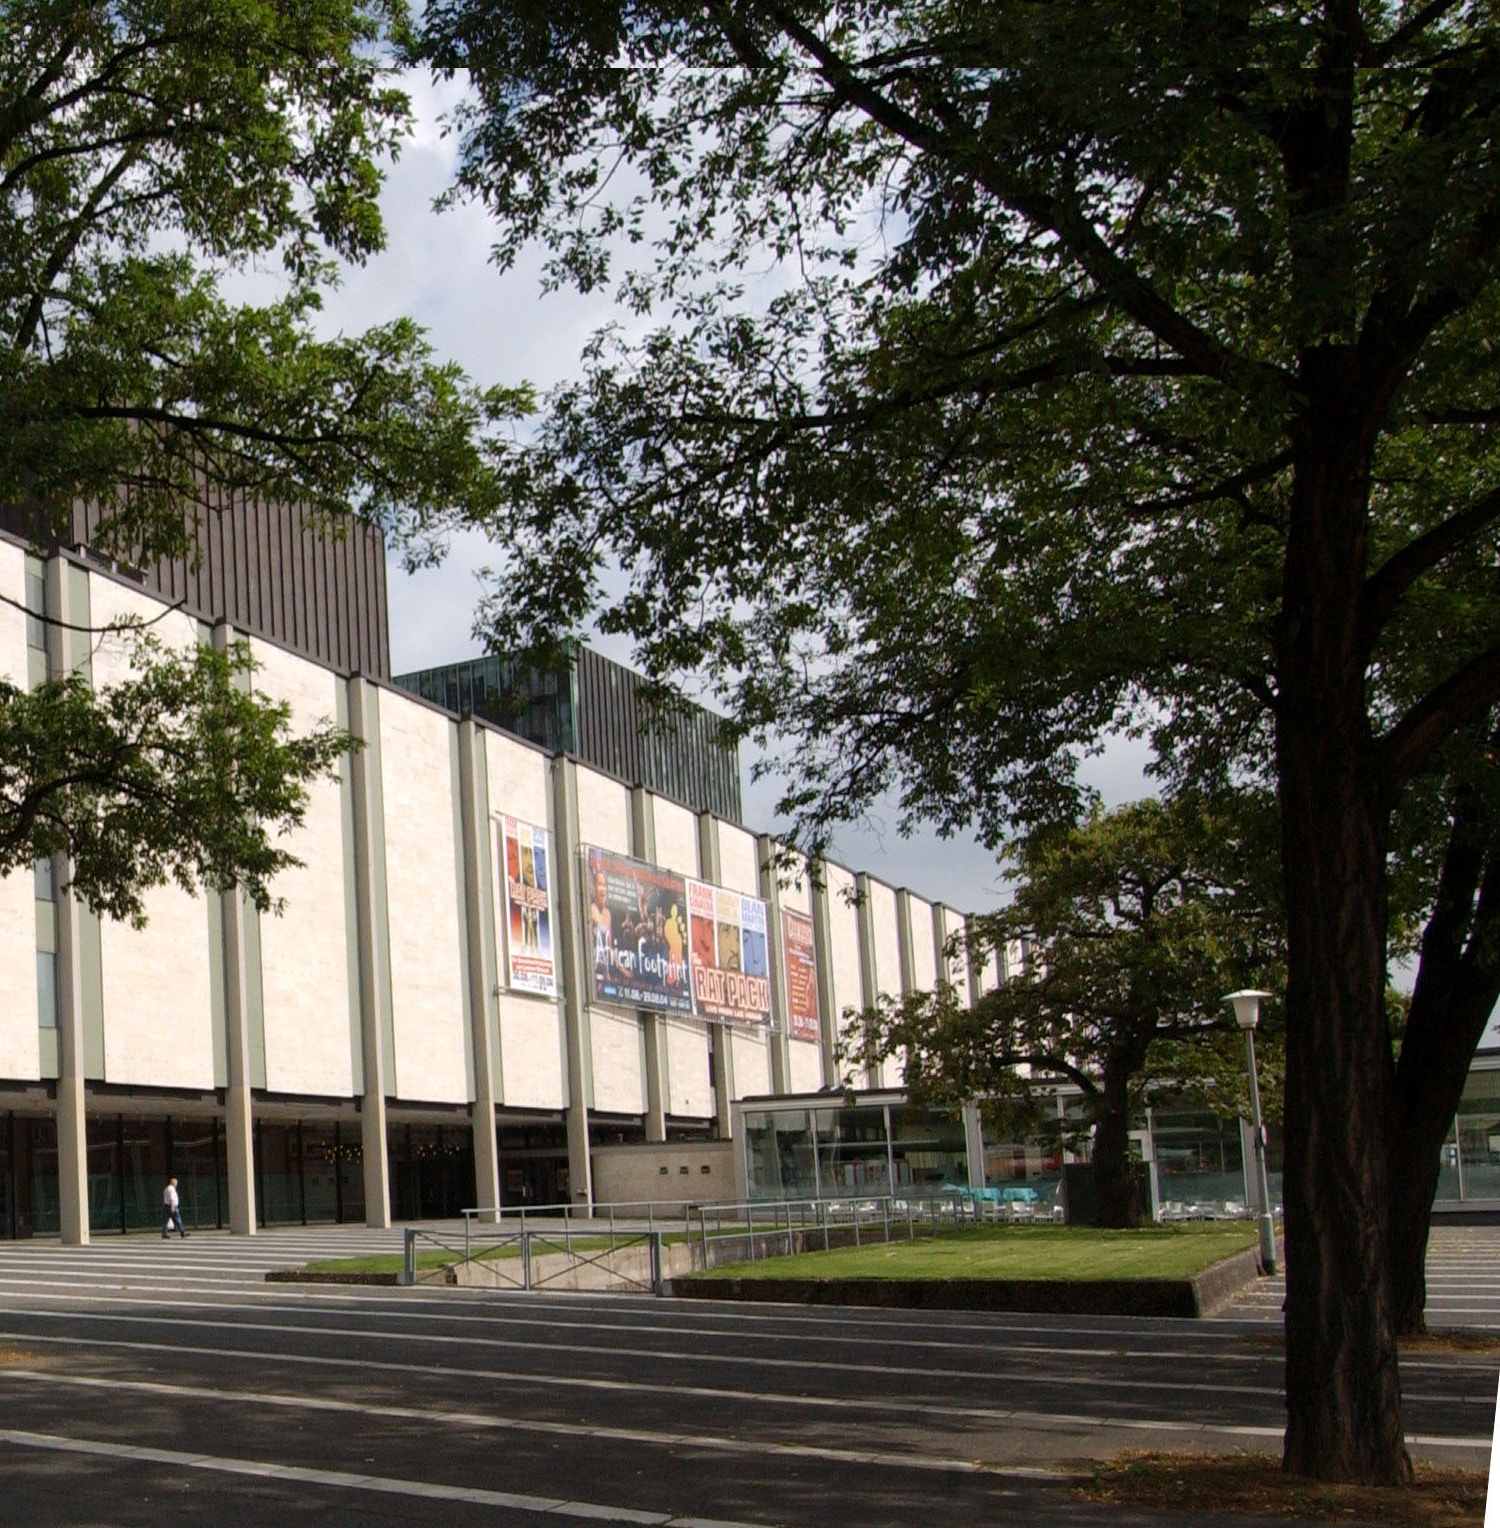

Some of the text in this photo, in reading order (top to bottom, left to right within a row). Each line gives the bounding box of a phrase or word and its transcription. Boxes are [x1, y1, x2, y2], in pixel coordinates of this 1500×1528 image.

[596, 928, 688, 988] African Footprint
[694, 965, 725, 1005] RAT
[726, 972, 769, 1012] PACK
